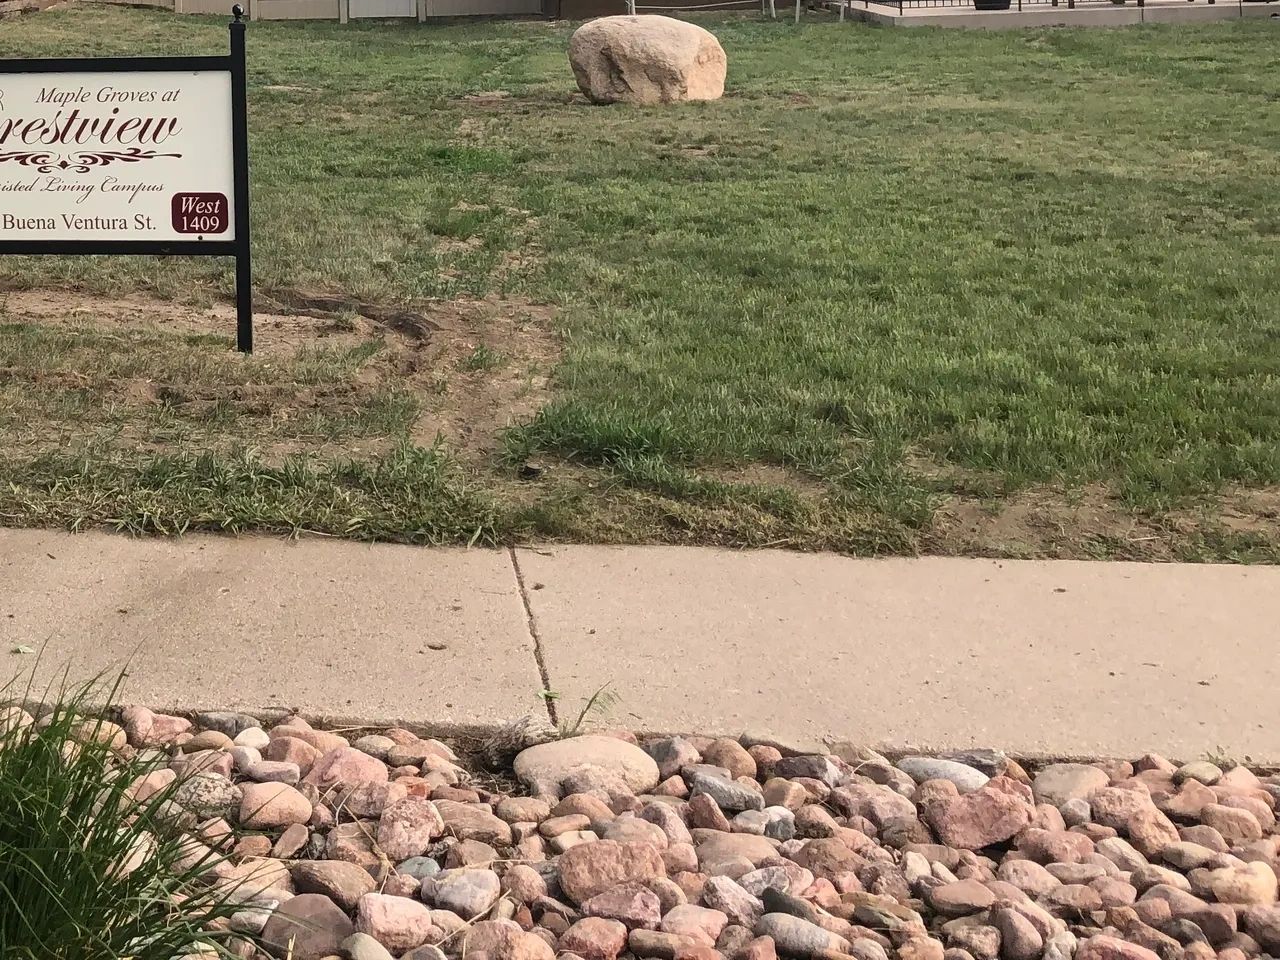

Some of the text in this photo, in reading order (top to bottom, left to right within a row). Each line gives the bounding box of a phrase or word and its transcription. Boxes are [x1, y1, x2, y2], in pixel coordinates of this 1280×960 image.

[35, 87, 181, 107] Maple Groves at
[40, 177, 95, 204] Living
[100, 176, 165, 204] Campus
[181, 196, 221, 214] West
[2, 214, 56, 230] Buena
[61, 214, 128, 230] Ventura
[134, 214, 157, 230] St.
[181, 215, 220, 231] 1409
